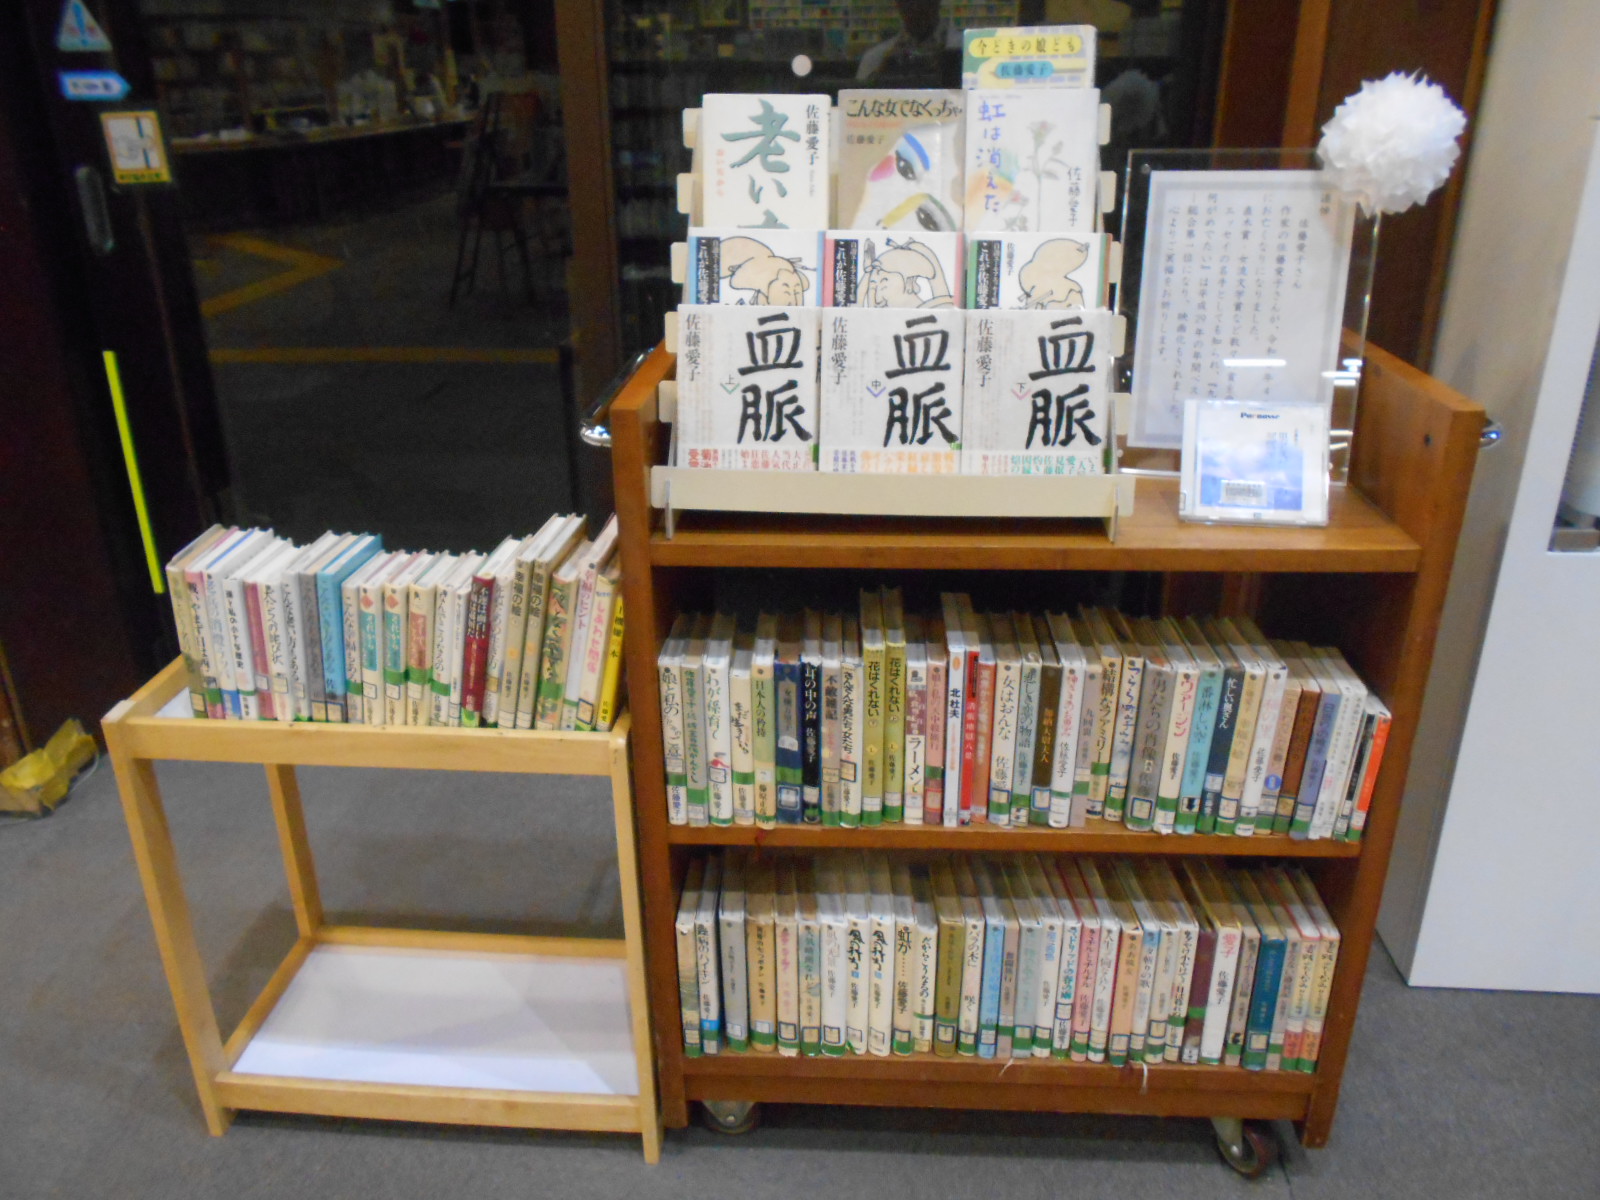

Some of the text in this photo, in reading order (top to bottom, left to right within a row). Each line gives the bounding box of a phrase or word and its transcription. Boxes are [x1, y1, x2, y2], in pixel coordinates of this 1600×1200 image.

[978, 37, 1076, 54] 今どきの娘ども
[1001, 63, 1047, 78] 佐藤愛子
[806, 104, 820, 165] 佐藤愛子
[977, 101, 1006, 213] 虹は消えた
[1067, 166, 1082, 227] 佐藤愛子
[1293, 218, 1309, 290] 佐藤愛子さん
[685, 313, 702, 382] 佐藤愛子
[737, 312, 813, 444] 血脈
[830, 316, 848, 385] 佐藤愛子
[976, 318, 994, 388] 佐藤愛子
[725, 374, 735, 385] 上
[871, 379, 881, 390] 中
[882, 314, 959, 448] 血脈
[1016, 382, 1027, 393] 下
[1026, 316, 1102, 450] 血脈
[867, 660, 881, 718] 花はくれない
[888, 657, 901, 714] 花はくれない
[948, 688, 961, 719] 北杜夫
[1219, 932, 1238, 959] 愛子
